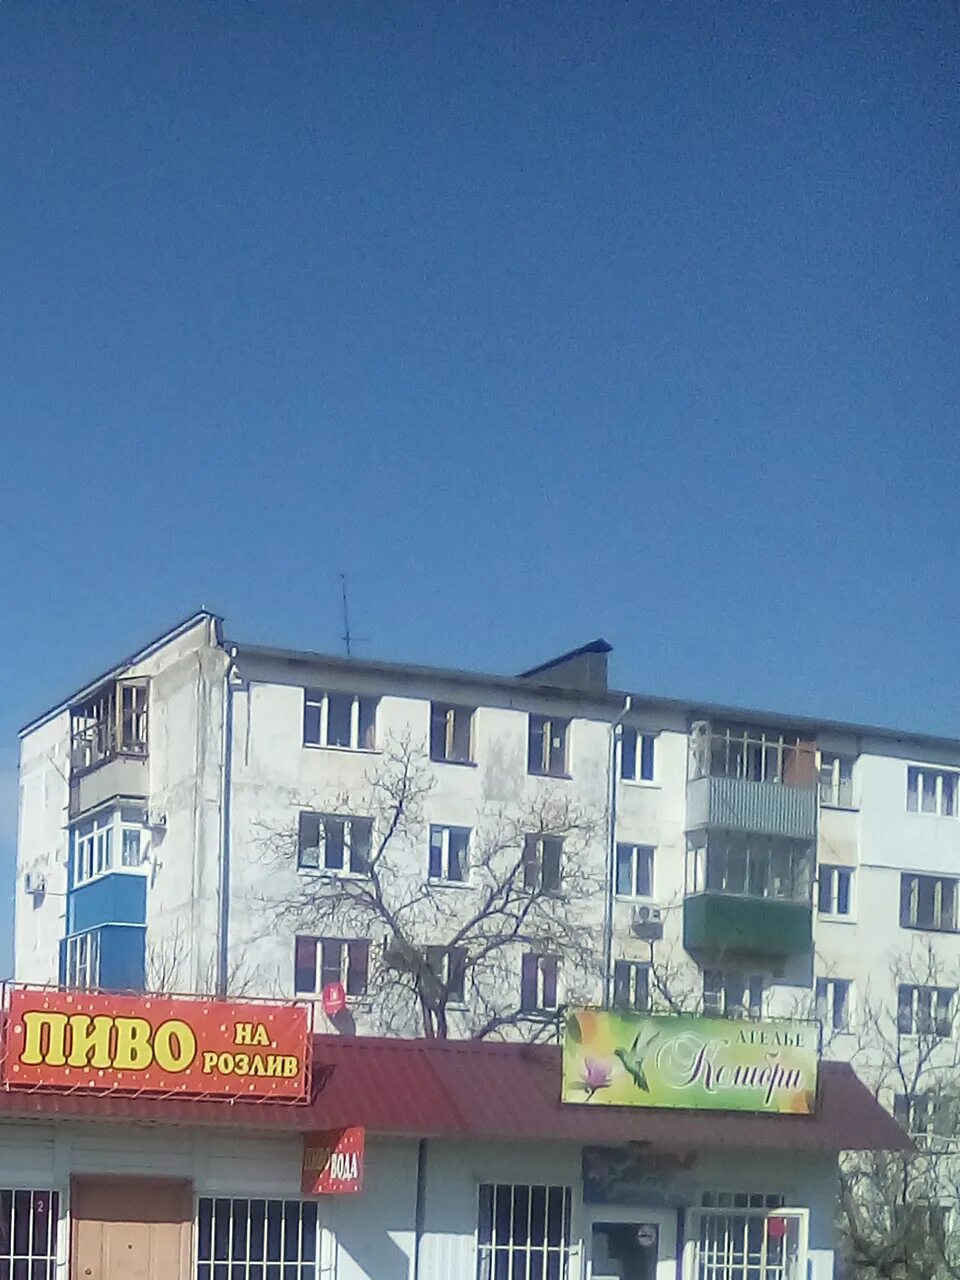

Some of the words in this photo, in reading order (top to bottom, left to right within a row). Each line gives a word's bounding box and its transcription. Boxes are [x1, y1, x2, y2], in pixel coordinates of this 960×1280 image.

[22, 1010, 196, 1073] ПИВО
[234, 1022, 271, 1046] НА
[736, 1029, 804, 1048] АТЕЛЬЕ
[203, 1052, 299, 1078] РОЗЛИВ
[330, 1153, 358, 1181] ВОДА
